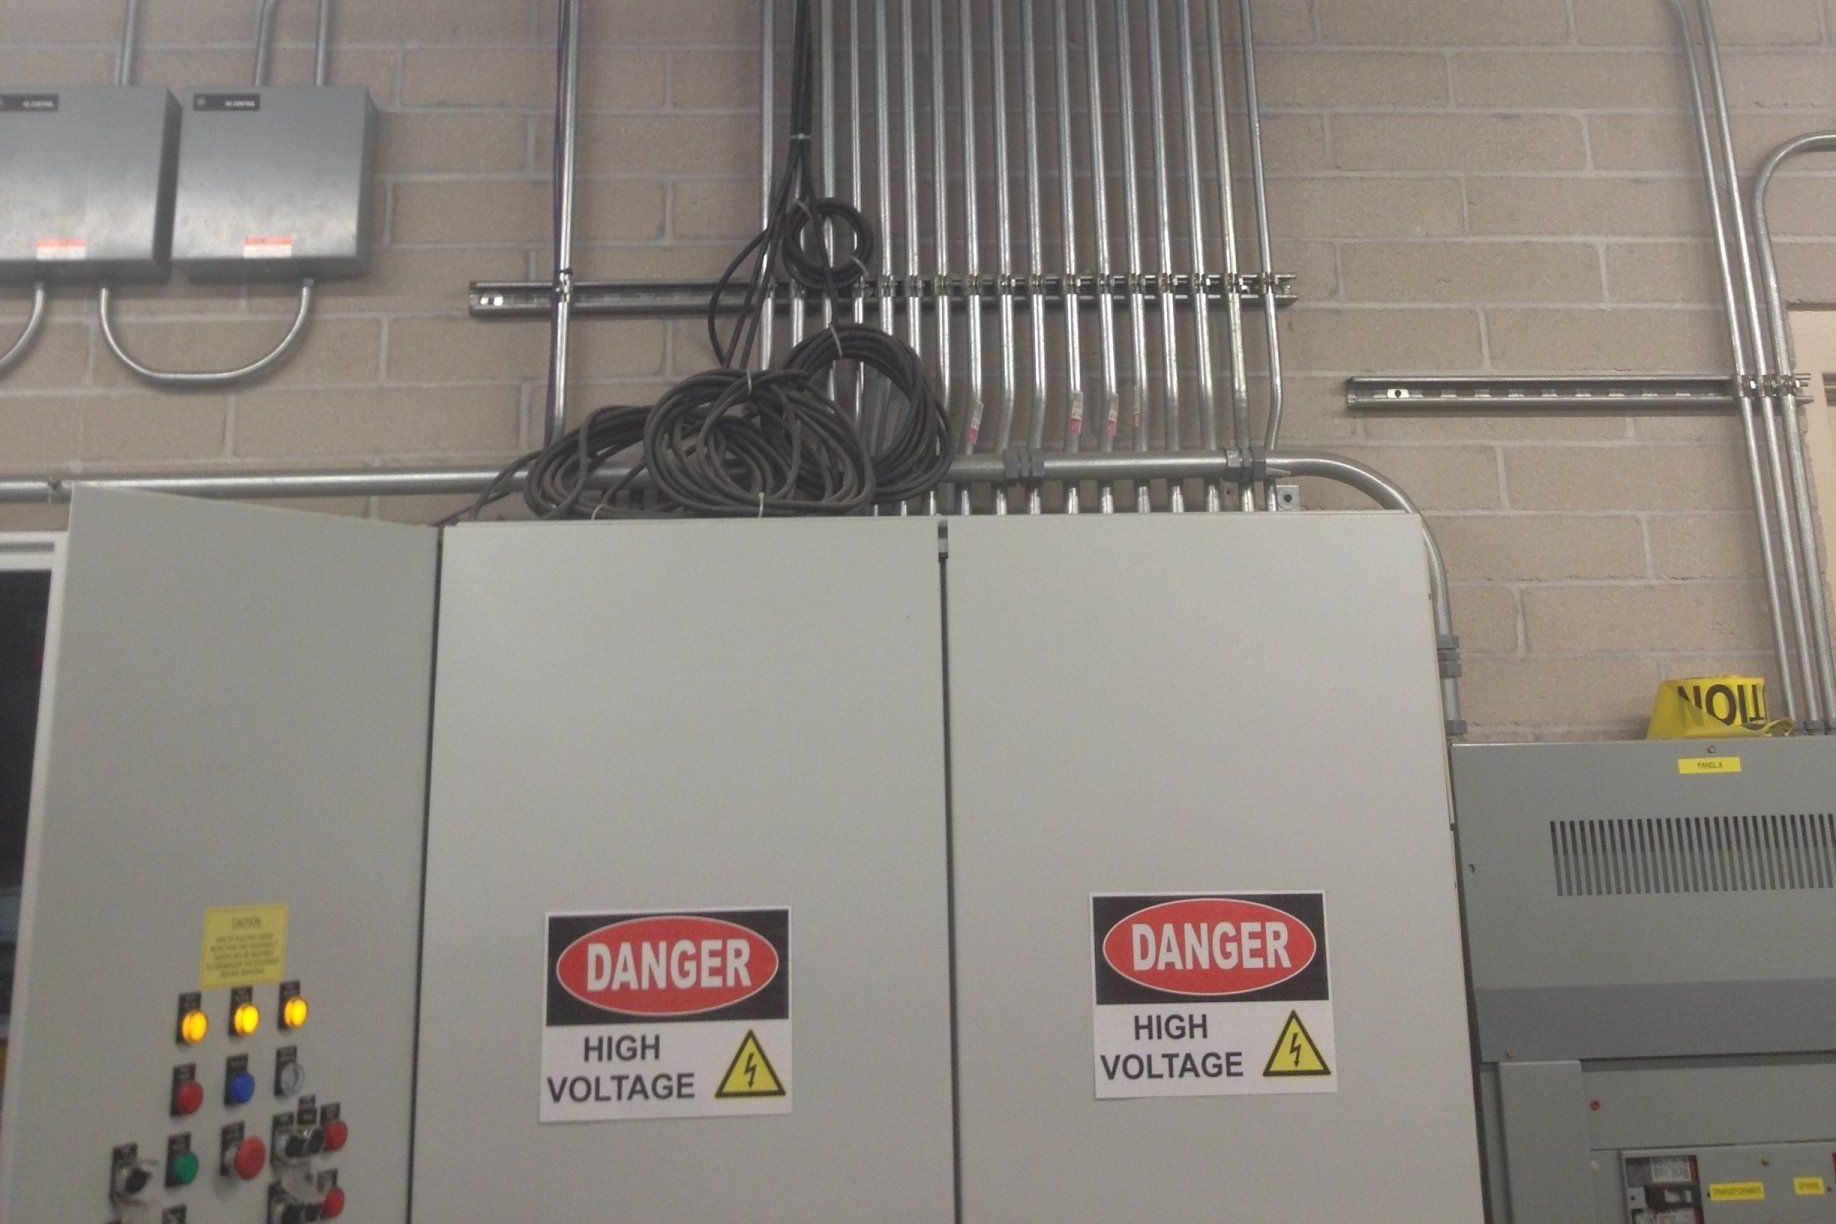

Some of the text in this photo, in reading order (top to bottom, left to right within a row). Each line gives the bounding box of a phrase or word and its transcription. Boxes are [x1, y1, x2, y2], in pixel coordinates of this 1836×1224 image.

[1131, 921, 1292, 971] DANGER
[586, 938, 752, 992] DANGER
[1134, 1014, 1209, 1040] HIGH
[583, 1034, 661, 1062] HIGH
[1100, 1051, 1244, 1080] VOLTAGE
[547, 1072, 696, 1103] VOLTAGE
